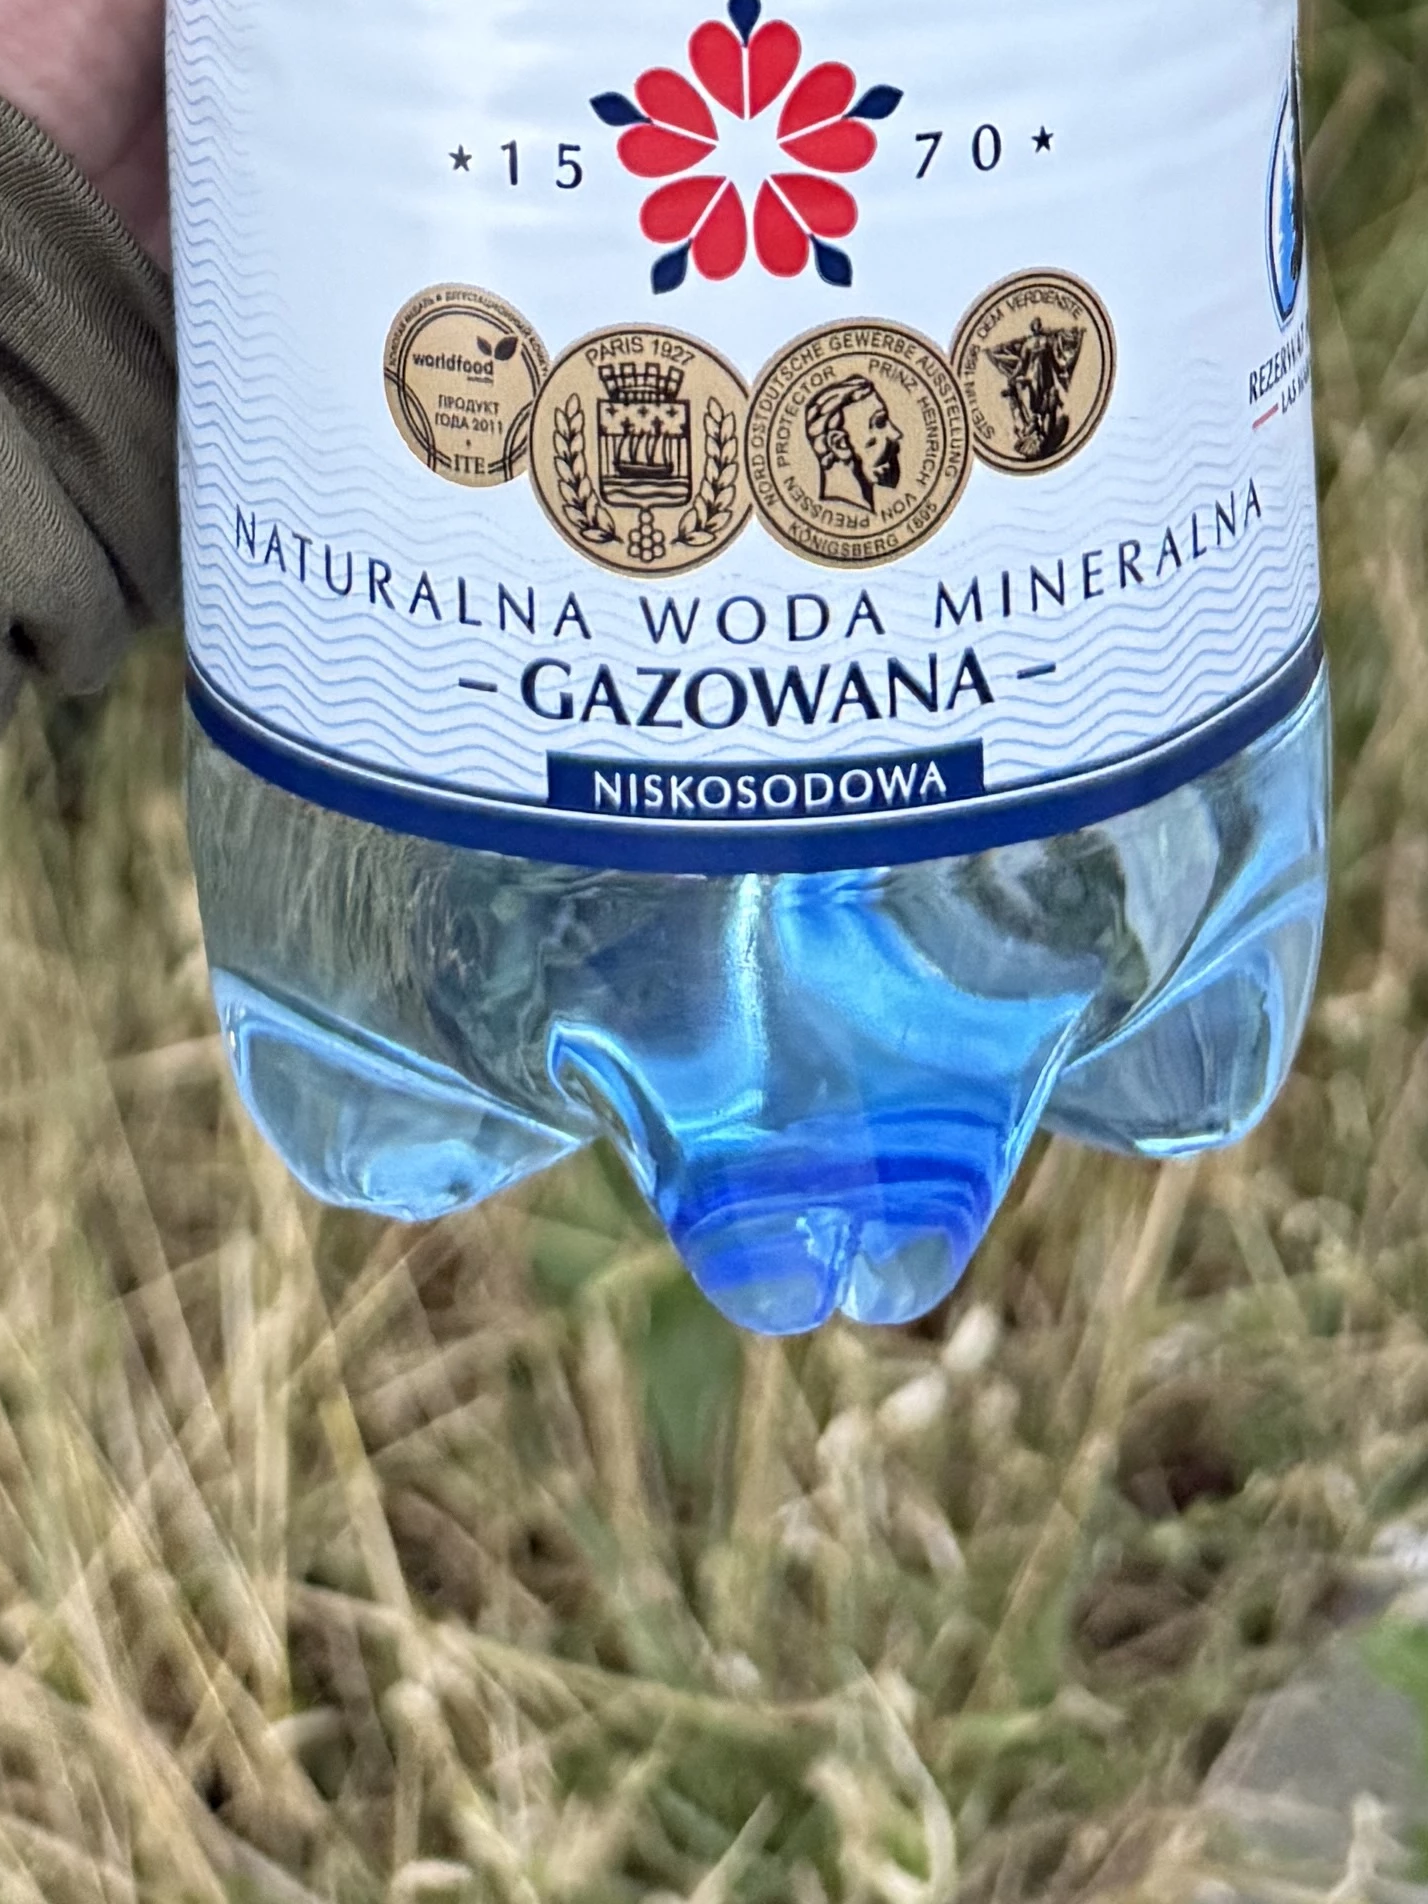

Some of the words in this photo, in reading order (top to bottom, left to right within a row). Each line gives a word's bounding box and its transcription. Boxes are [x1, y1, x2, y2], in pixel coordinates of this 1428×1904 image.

[500, 140, 583, 189] 15
[914, 123, 1003, 180] 70
[977, 308, 1005, 340] DEM
[1006, 289, 1084, 320] VERDIENSTE
[412, 352, 494, 376] worldfood
[584, 336, 645, 368] PARIS
[651, 338, 697, 366] 1927
[867, 358, 919, 393] PRINZ
[435, 412, 470, 429] ГОДА
[472, 417, 503, 434] 2011
[438, 393, 501, 416] ПРОДУКТ
[751, 454, 779, 506] NORD
[828, 331, 917, 360] GEWERBE
[915, 355, 967, 479] AUSSTELLUNG
[775, 364, 837, 469] PROTECTOR
[453, 453, 486, 474] ITE
[916, 392, 941, 487] HEINRICH
[783, 475, 871, 530] PREUSSEN
[880, 492, 918, 524] VON
[234, 503, 592, 641] NATURALNA
[639, 590, 886, 646] WODA
[934, 476, 1263, 630] MINERALNA
[787, 522, 900, 558] KÖNIGSBERG
[520, 653, 996, 731] GAZOWANA
[592, 760, 949, 811] NISKOSODOWA
